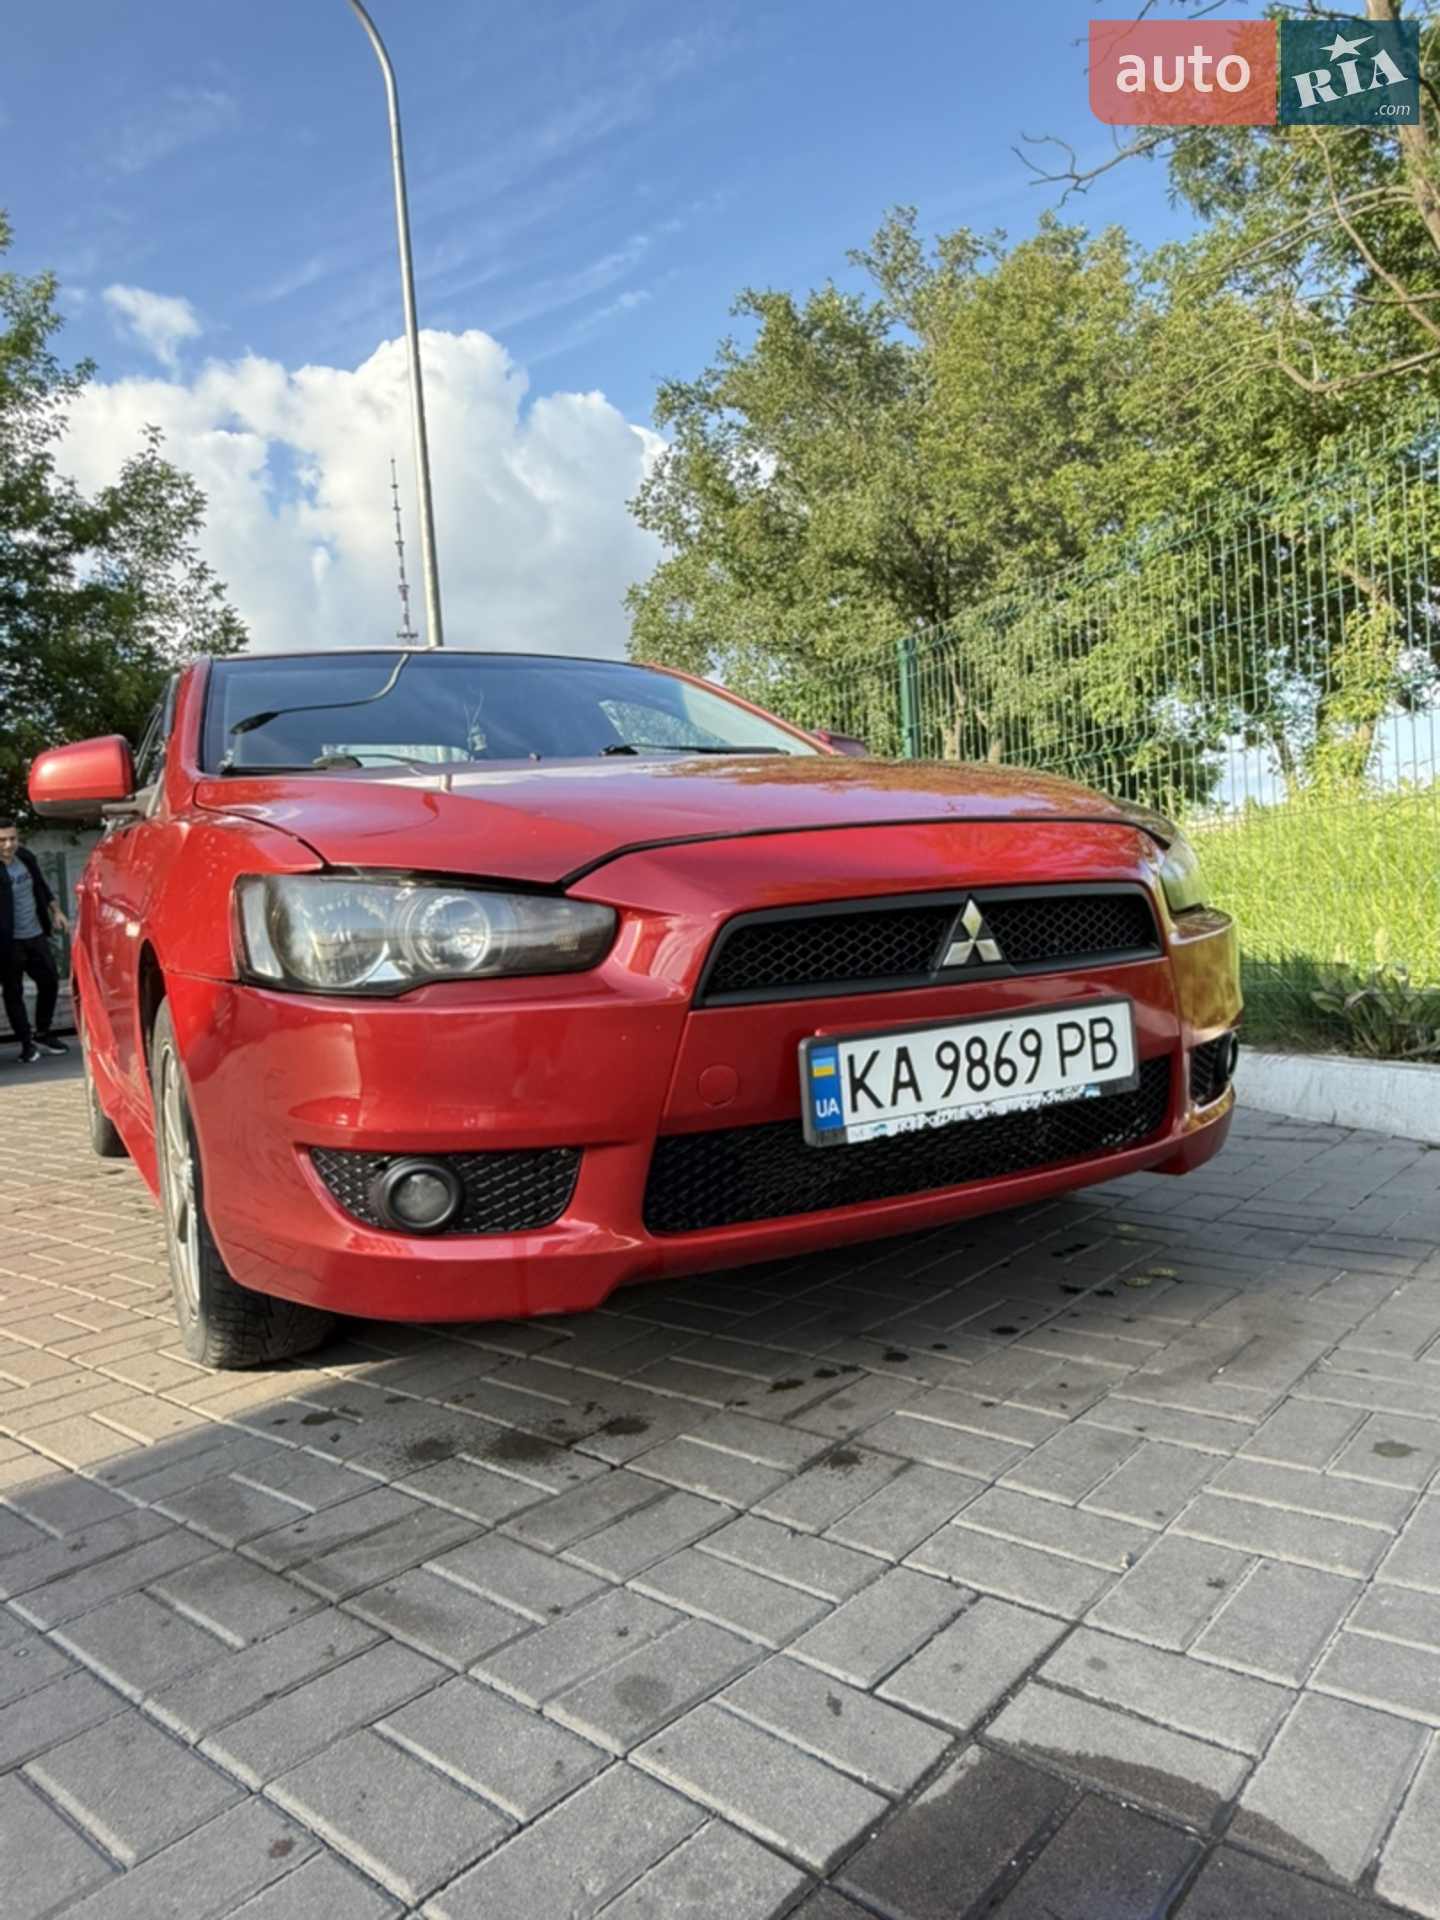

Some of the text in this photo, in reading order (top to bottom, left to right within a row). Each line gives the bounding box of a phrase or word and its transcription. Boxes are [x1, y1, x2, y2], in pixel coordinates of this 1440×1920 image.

[847, 1016, 1118, 1113] KA 9869 PB
[816, 1097, 840, 1118] UA
